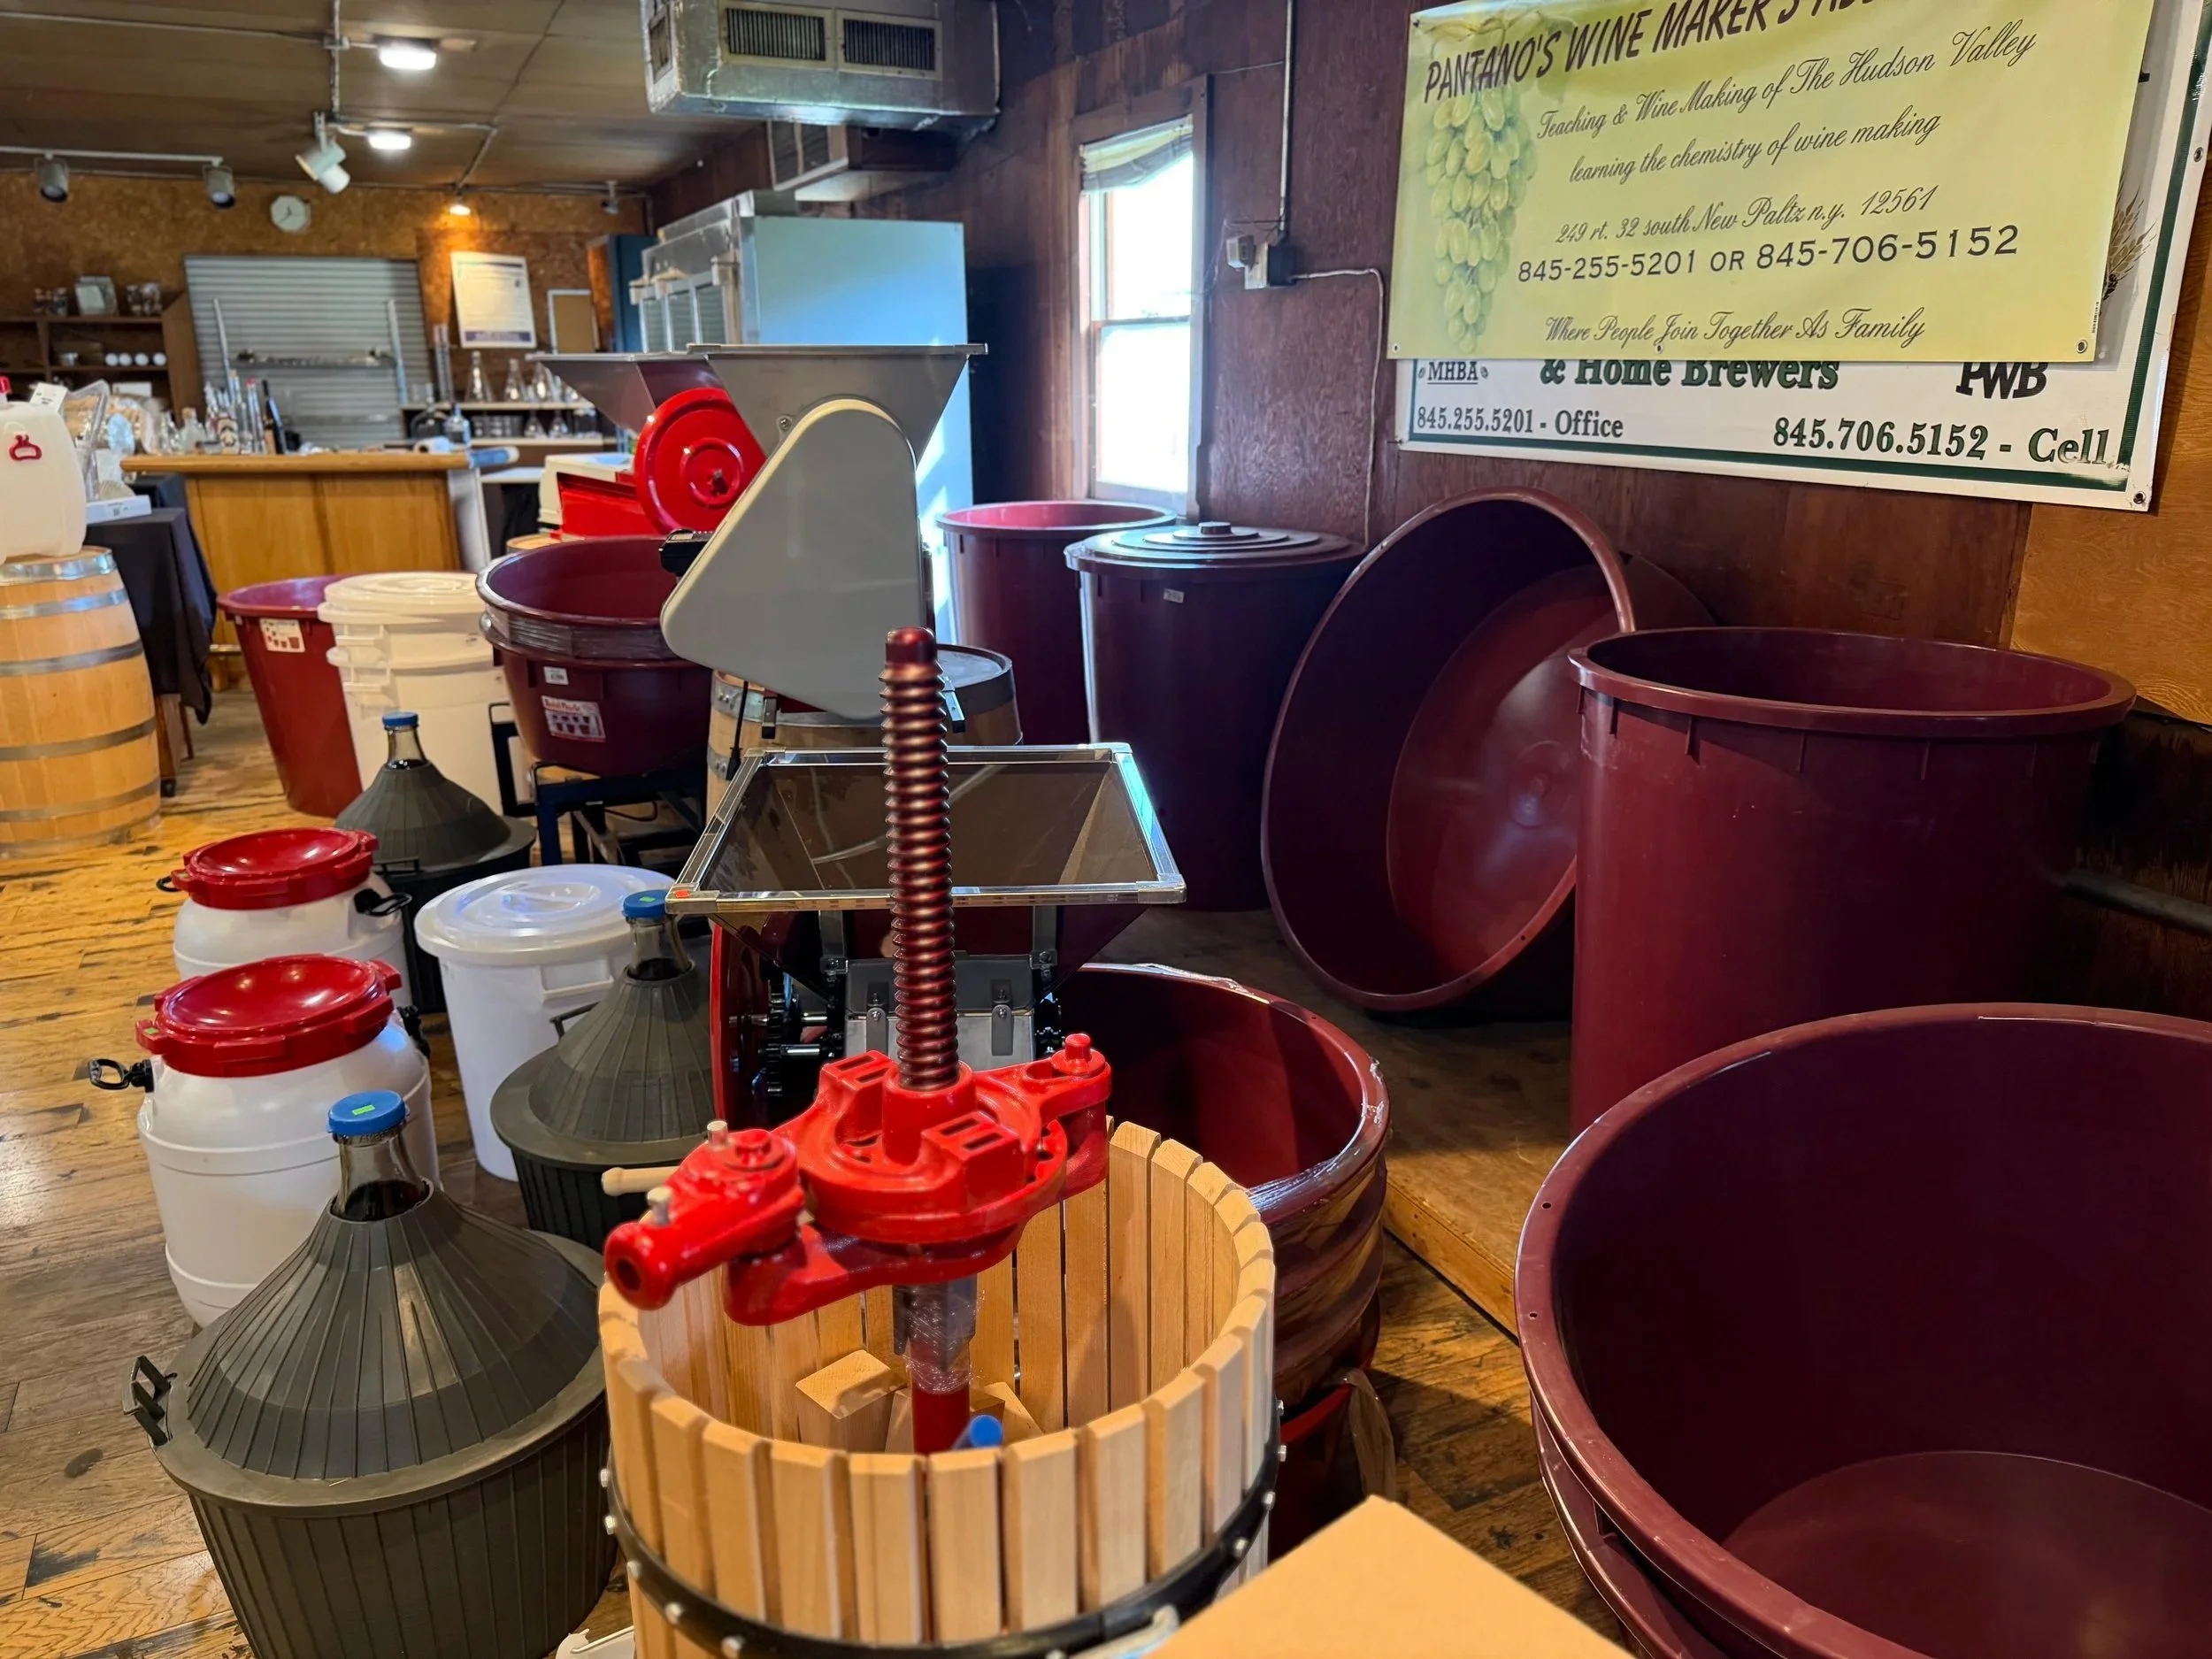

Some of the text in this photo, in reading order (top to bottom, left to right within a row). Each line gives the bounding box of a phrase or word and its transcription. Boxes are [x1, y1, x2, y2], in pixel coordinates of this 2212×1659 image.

[1424, 0, 1800, 104] PANTANO'S WINE MAKER
[1537, 19, 2037, 139] Teaching & Wine Making of The Hudson Valley
[1569, 104, 1942, 185] learning the chemistry of wine making
[1555, 184, 1940, 243] 249 rt. 32 south New Paltz n.y. 12561
[1517, 224, 2019, 283] 845-255-5201 OR 845-706-5152
[1545, 306, 1926, 349] Where People Join Together As Family
[1427, 361, 1479, 380] MHBA
[1540, 360, 1840, 390] & Home Brewers
[1955, 361, 2050, 400] PWB
[1417, 405, 1534, 434] 845.255.5201
[1555, 410, 1624, 439] Office
[1773, 417, 2111, 465] 845.706.5152 - Cell
